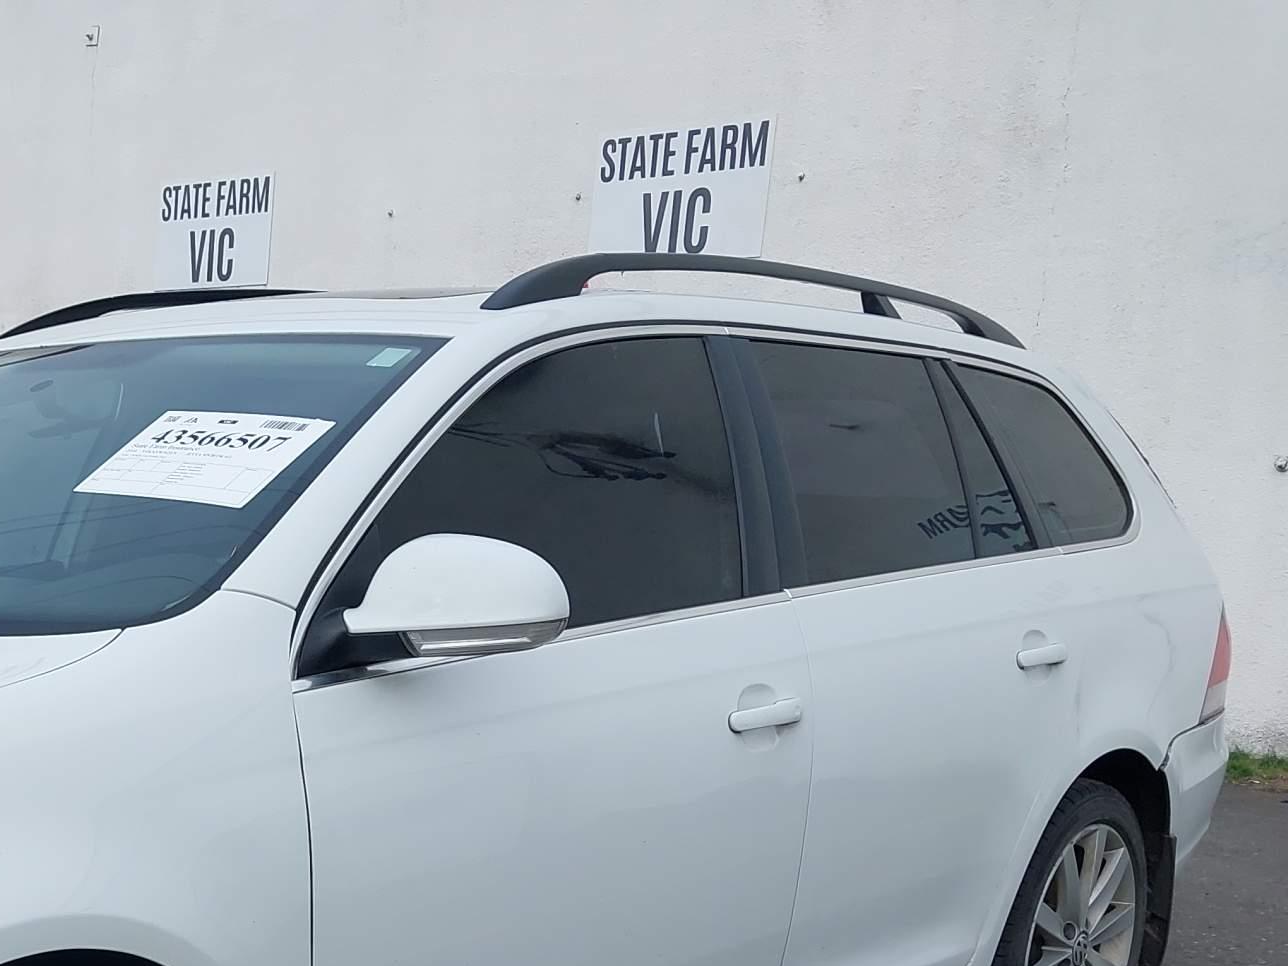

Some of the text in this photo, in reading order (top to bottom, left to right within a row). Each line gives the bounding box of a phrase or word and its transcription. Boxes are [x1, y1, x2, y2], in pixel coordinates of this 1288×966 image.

[601, 120, 770, 184] STATE FARM
[161, 175, 270, 222] STATE FARM
[642, 187, 712, 254] VIC
[189, 227, 235, 283] VIC
[152, 429, 293, 452] 43566507
